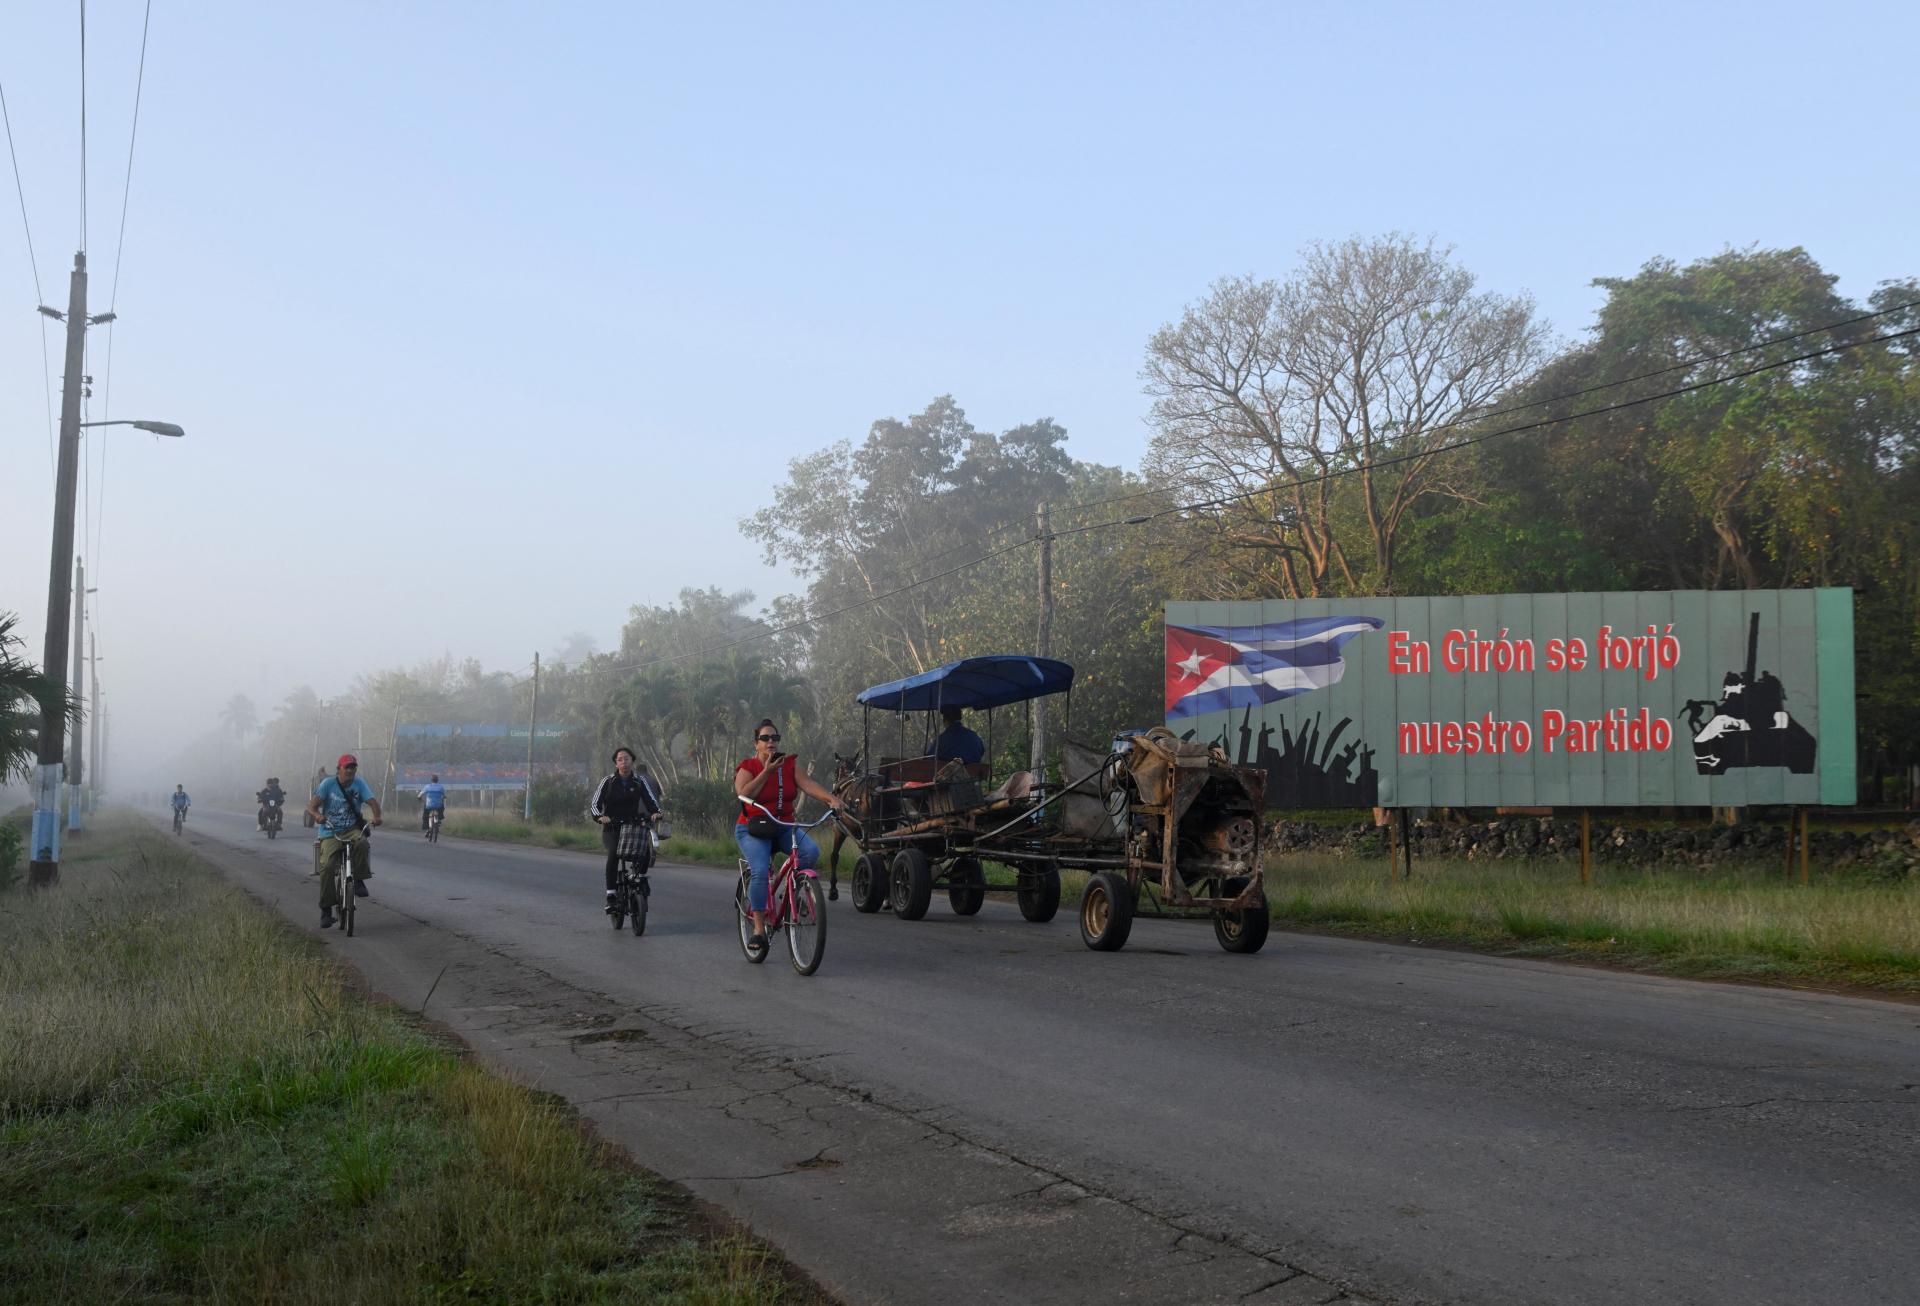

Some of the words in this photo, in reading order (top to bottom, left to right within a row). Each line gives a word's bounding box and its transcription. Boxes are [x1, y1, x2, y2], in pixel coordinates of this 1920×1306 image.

[1387, 630, 1431, 674] En
[1442, 627, 1535, 673] Girón
[1545, 637, 1588, 672] se
[1597, 622, 1681, 681] forjó
[1399, 710, 1533, 755] nuestro
[1541, 707, 1673, 753] Partido
